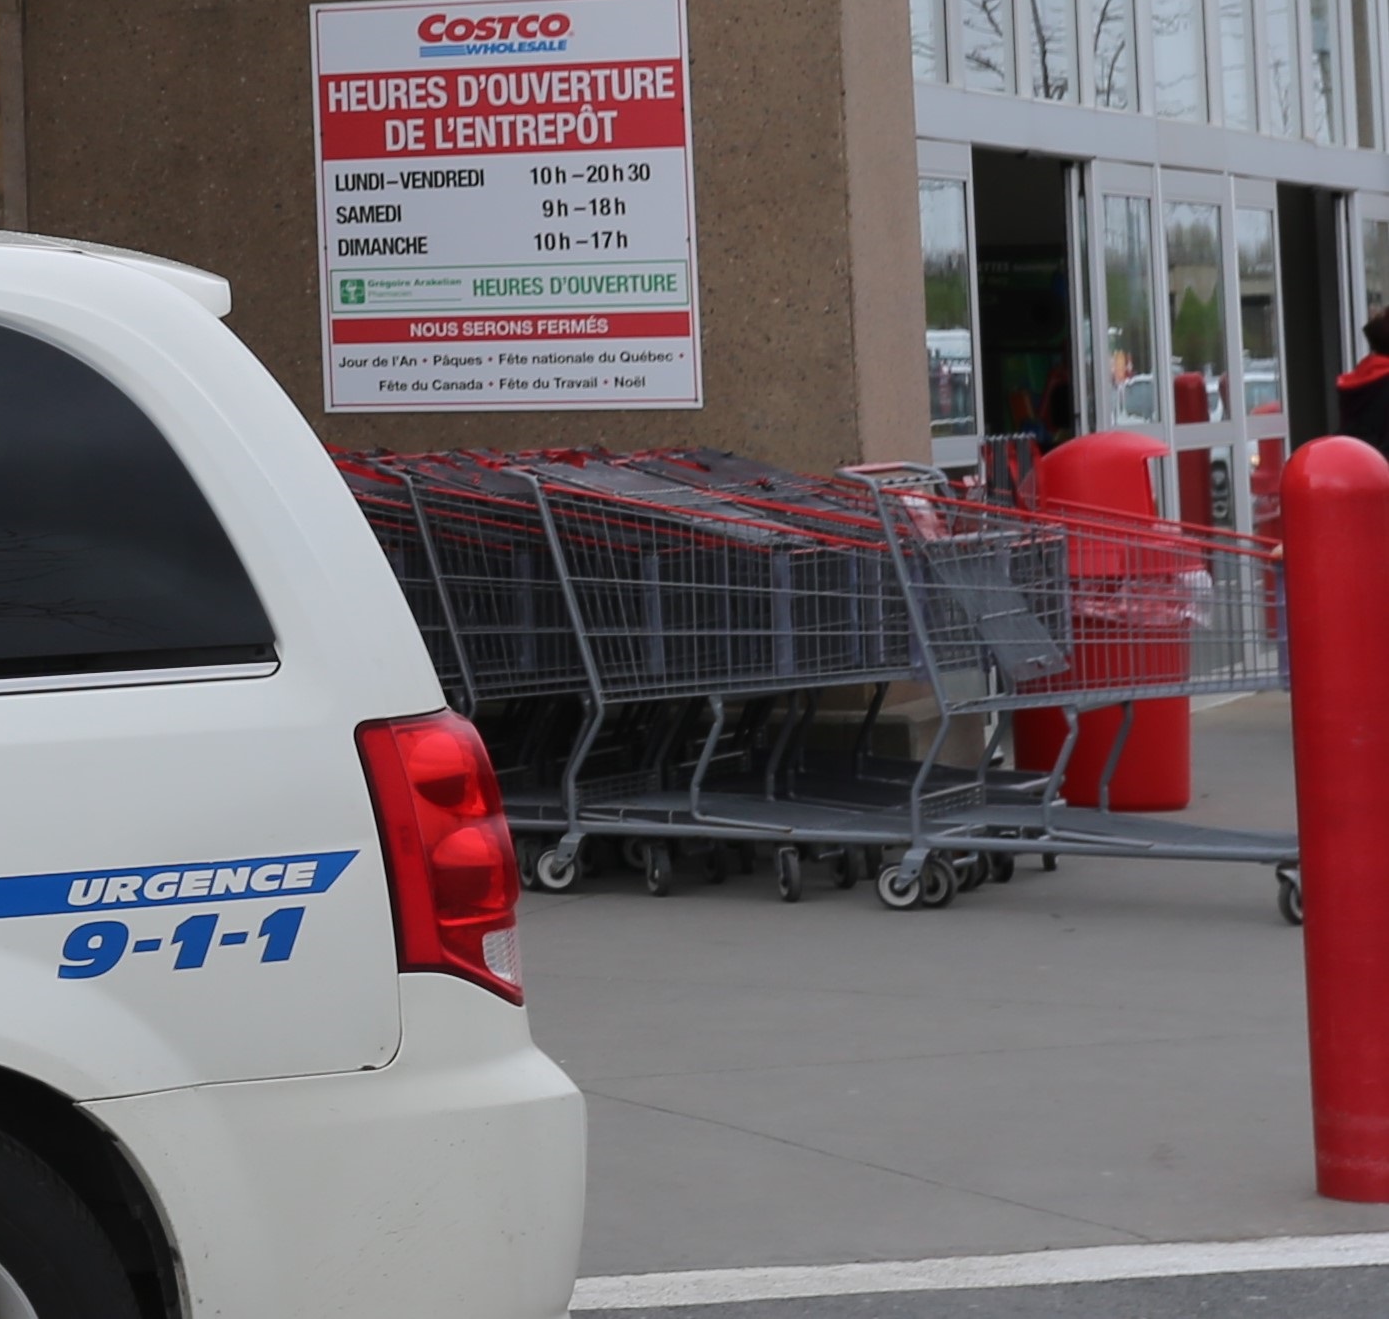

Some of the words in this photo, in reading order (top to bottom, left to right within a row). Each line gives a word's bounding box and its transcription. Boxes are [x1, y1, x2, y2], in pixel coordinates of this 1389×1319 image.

[417, 12, 571, 43] COSTCO
[466, 40, 567, 55] WHOLESALE
[328, 76, 447, 112] HEURES
[457, 66, 675, 107] D'OUVERTURE
[385, 118, 425, 152] DE
[336, 205, 402, 224] SAMEDI
[338, 236, 428, 257] DIMANCHE
[473, 277, 543, 297] HEURES
[551, 273, 677, 295] D'OUVERTURE
[410, 321, 459, 337] NOUS
[462, 320, 533, 336] SERONS
[537, 316, 609, 335] FERMÉS
[338, 357, 368, 369] Jour
[372, 356, 388, 367] de
[433, 354, 483, 369] Pâques
[498, 353, 528, 365] Fête
[532, 352, 594, 364] nationale
[598, 351, 616, 363] du
[620, 349, 673, 363] Québec
[379, 379, 408, 391] Fête
[412, 379, 429, 391] du
[432, 379, 483, 391] Canada
[499, 377, 528, 389] Fête
[532, 377, 550, 389] du
[554, 376, 598, 388] Travail
[614, 375, 646, 388] Noël
[67, 860, 318, 906] URGENCE
[57, 906, 306, 979] 9-1-1
